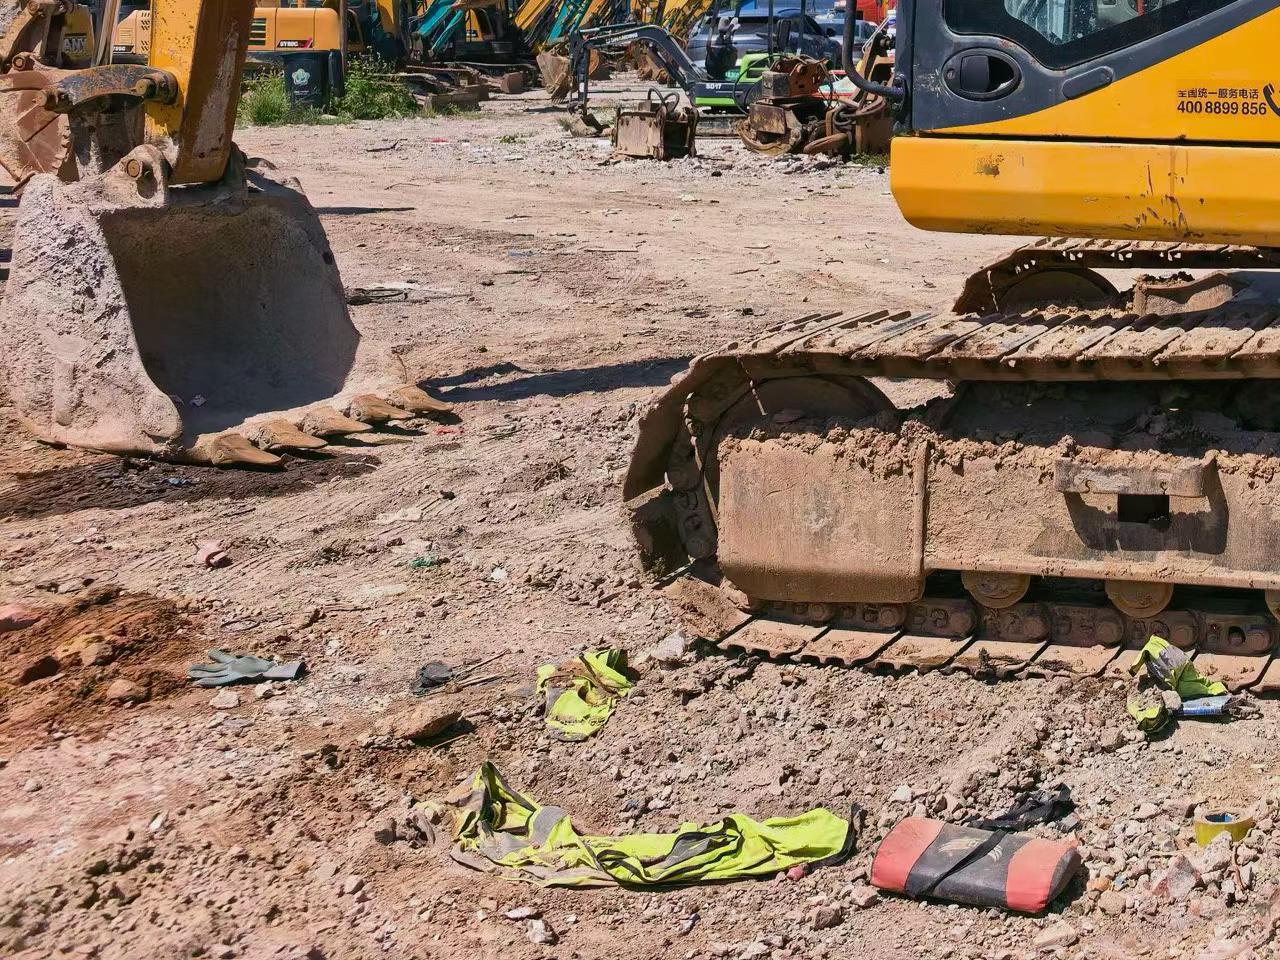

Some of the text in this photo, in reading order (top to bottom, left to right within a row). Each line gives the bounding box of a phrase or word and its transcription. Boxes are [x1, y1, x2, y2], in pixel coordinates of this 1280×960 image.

[62, 37, 88, 53] ANY
[1177, 100, 1267, 115] 400 8899 856
